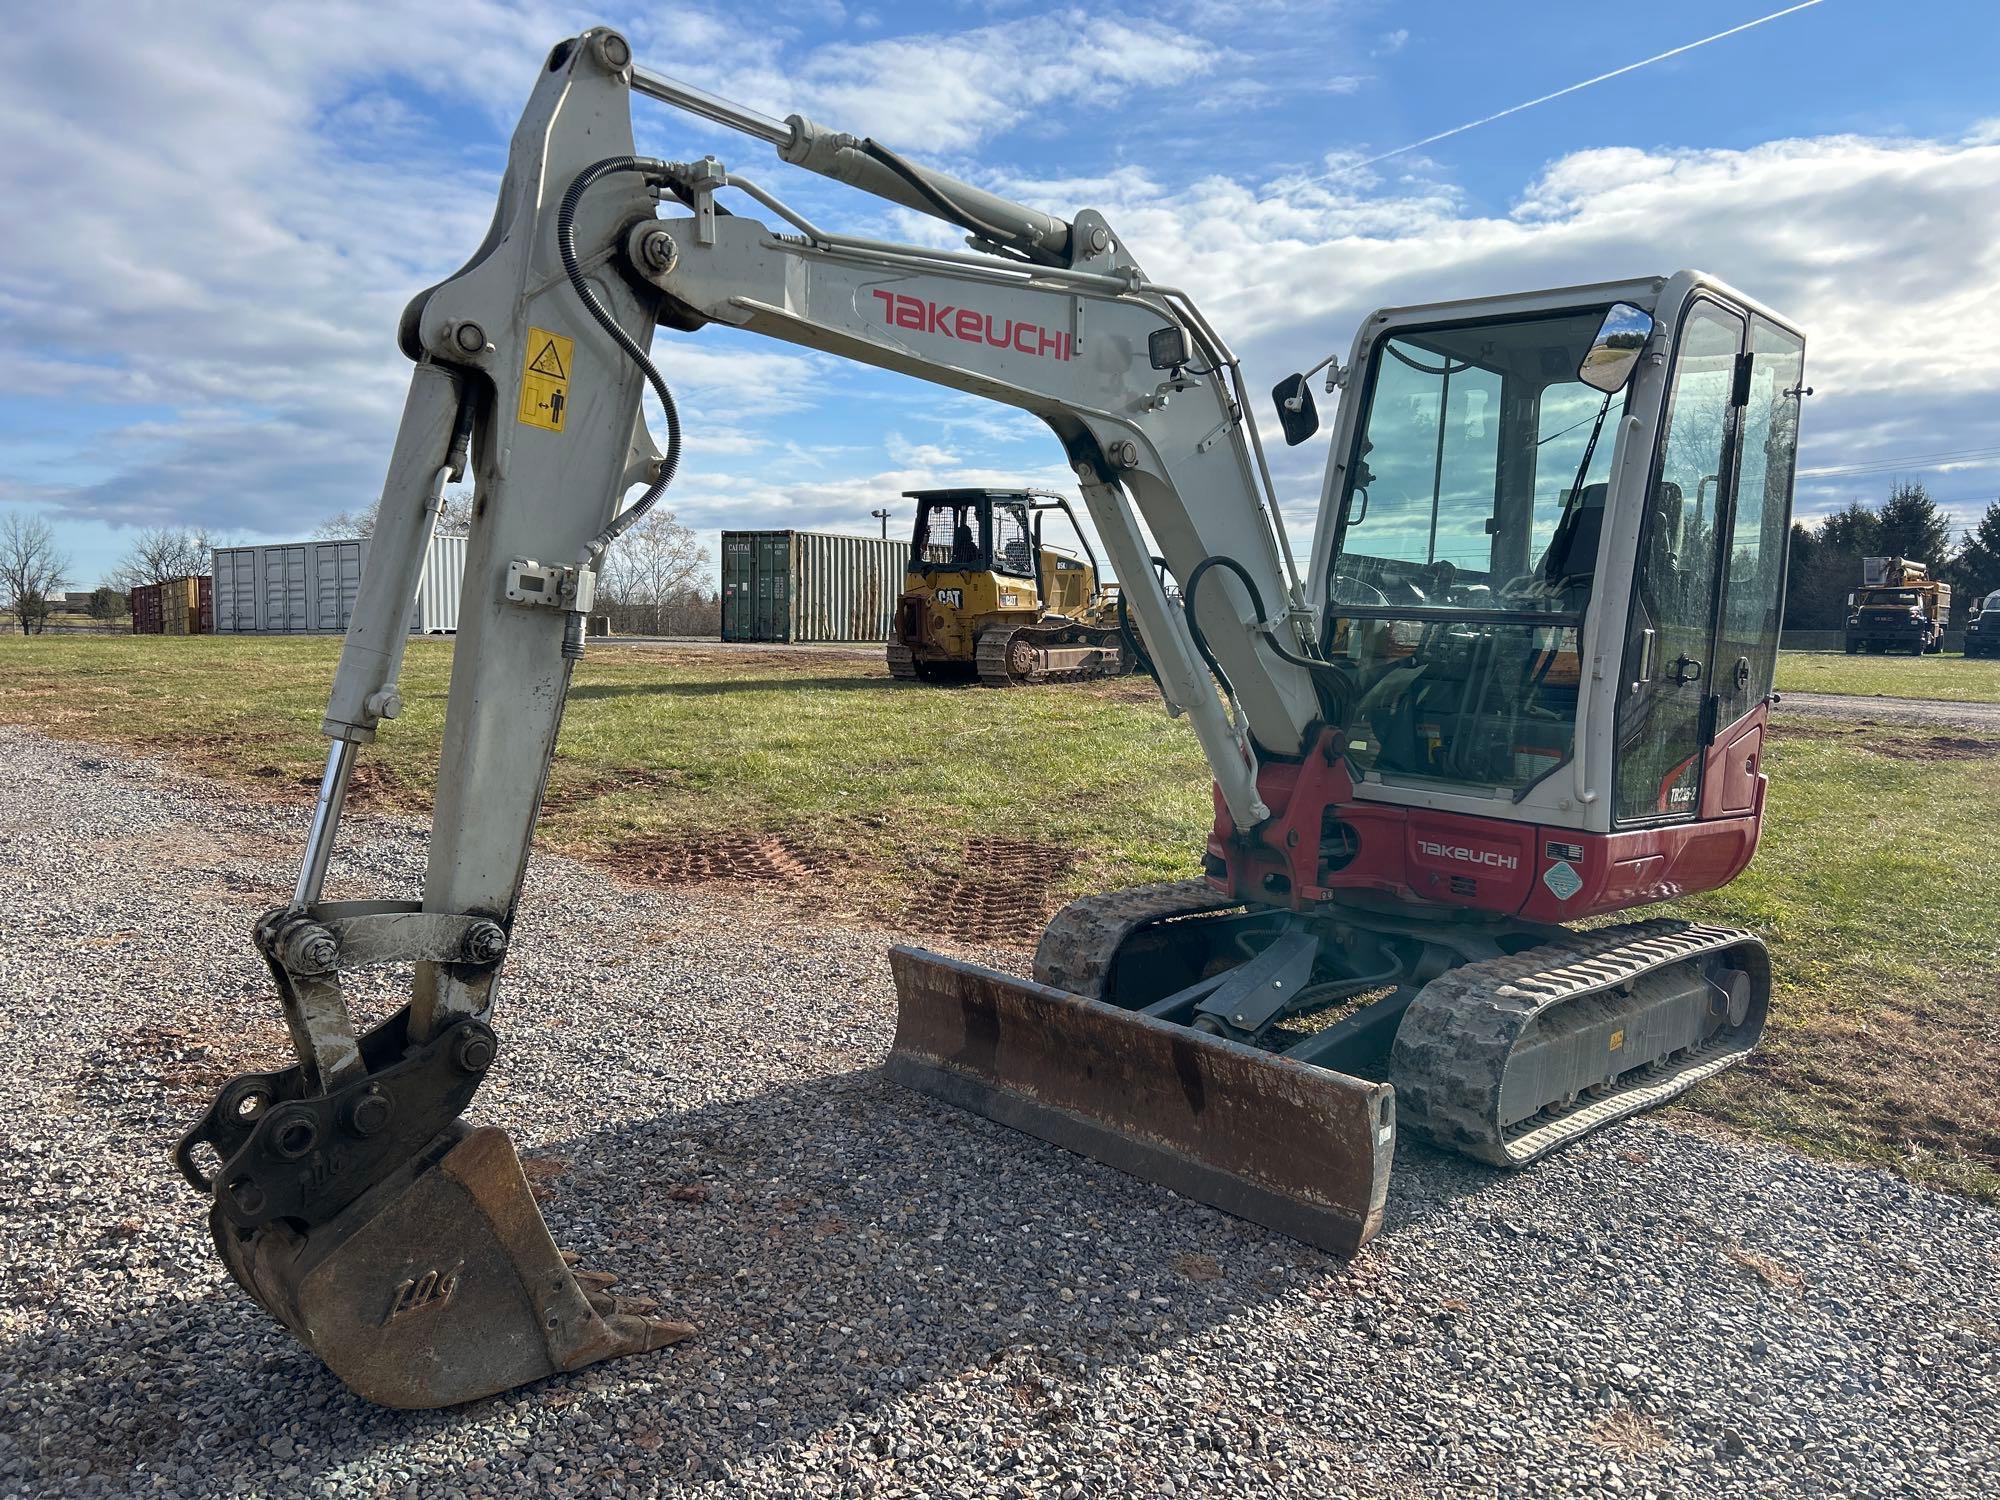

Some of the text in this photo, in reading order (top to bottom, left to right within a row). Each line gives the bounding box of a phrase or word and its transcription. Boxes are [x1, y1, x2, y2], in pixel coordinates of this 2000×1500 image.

[872, 289, 1071, 362] TAKEUCHI
[938, 590, 960, 609] CAT
[1005, 595, 1017, 606] CAT
[1417, 840, 1518, 870] TAKEUCHI
